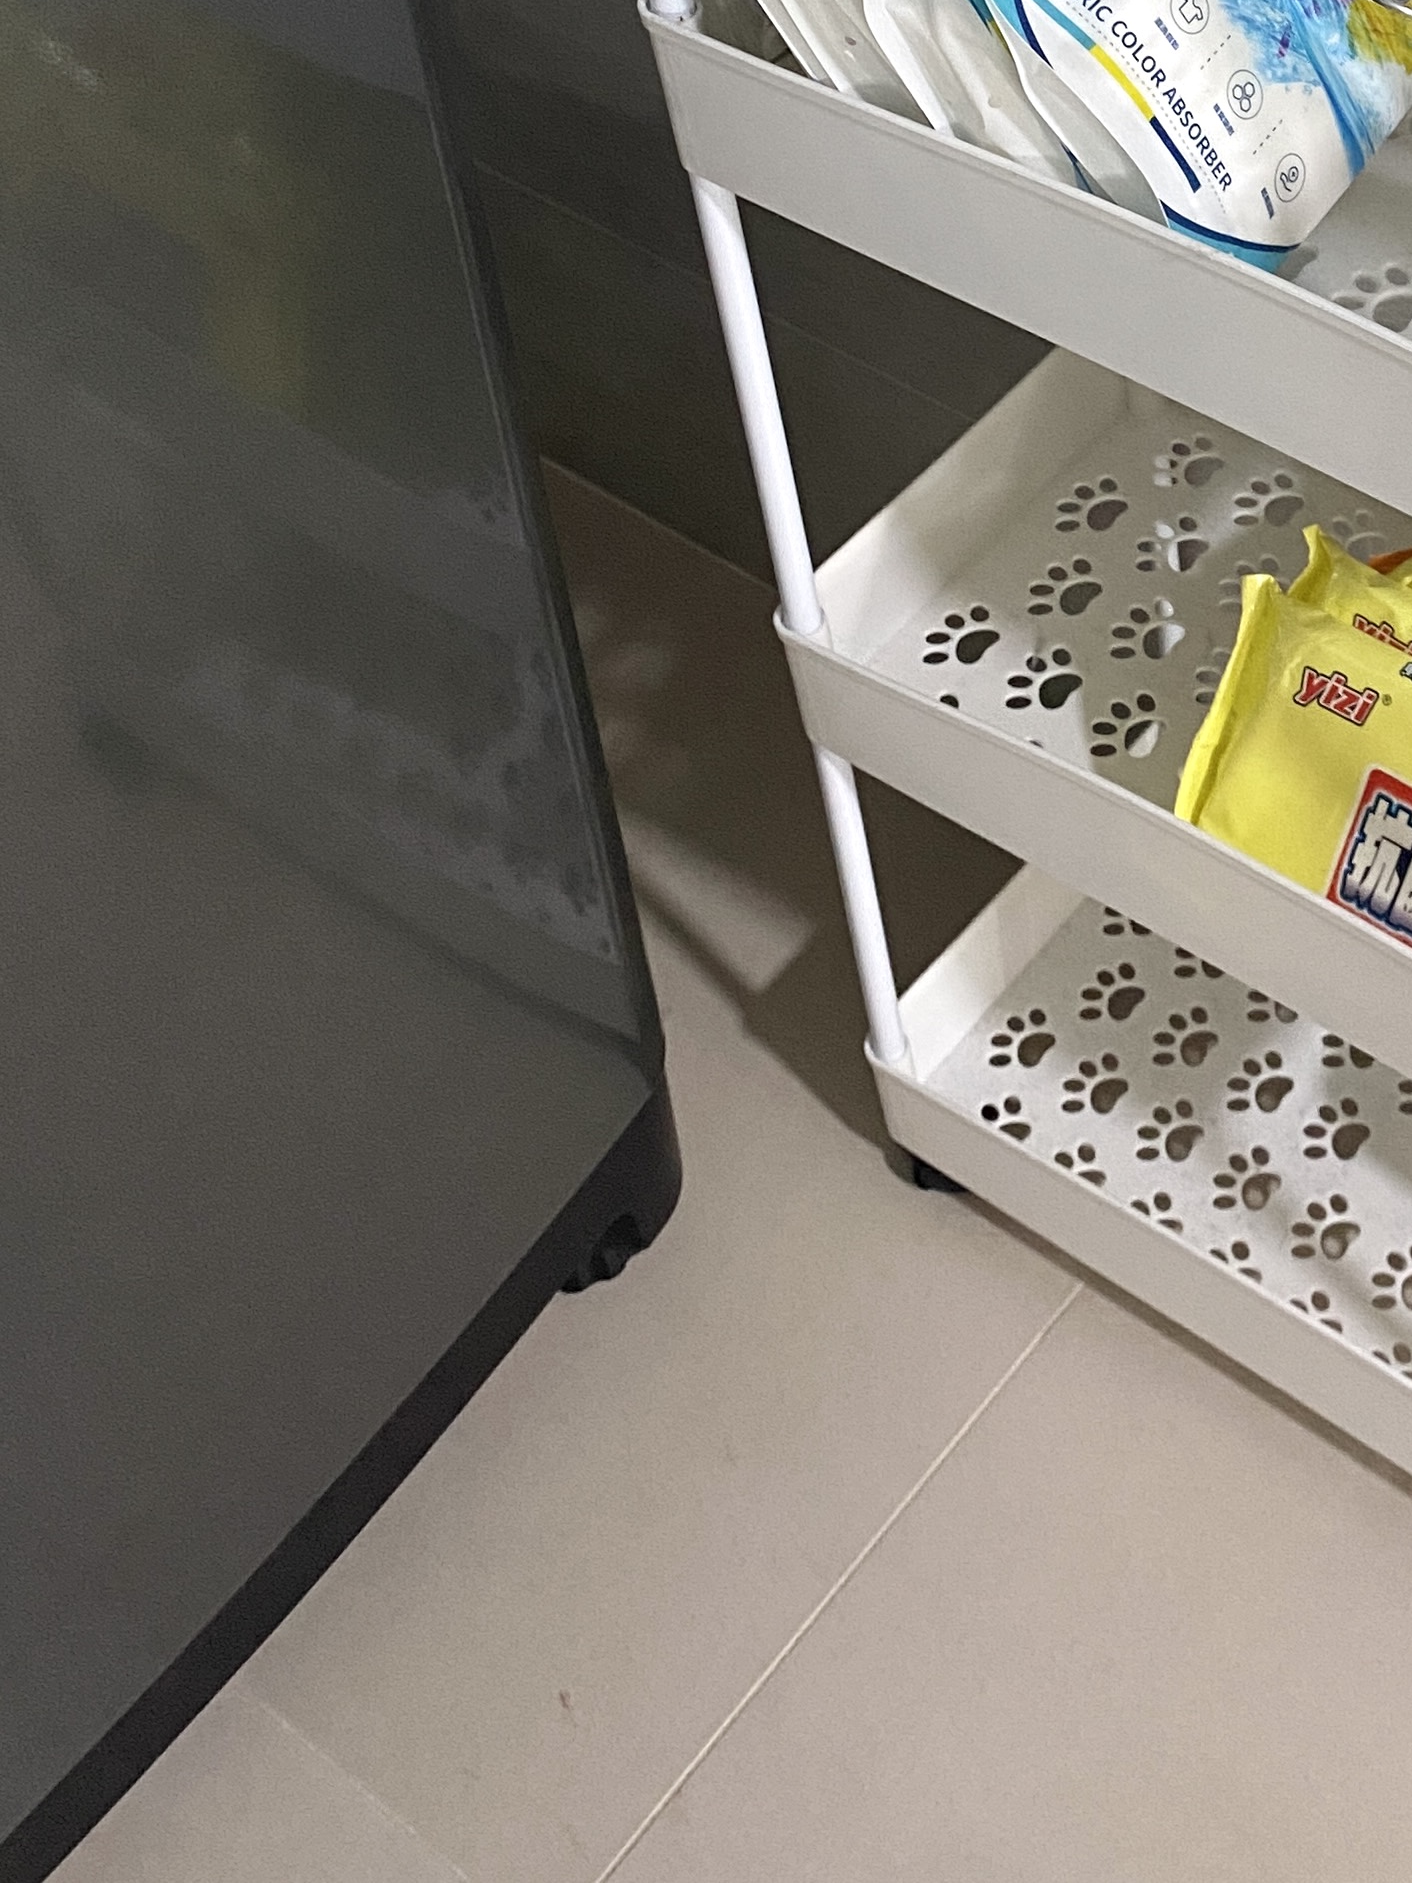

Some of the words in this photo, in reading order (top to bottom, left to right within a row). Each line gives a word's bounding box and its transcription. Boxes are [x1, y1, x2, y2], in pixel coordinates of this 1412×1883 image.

[1111, 20, 1166, 88] COLOR
[1162, 87, 1232, 192] ABSORBER
[1293, 666, 1379, 726] yizi
